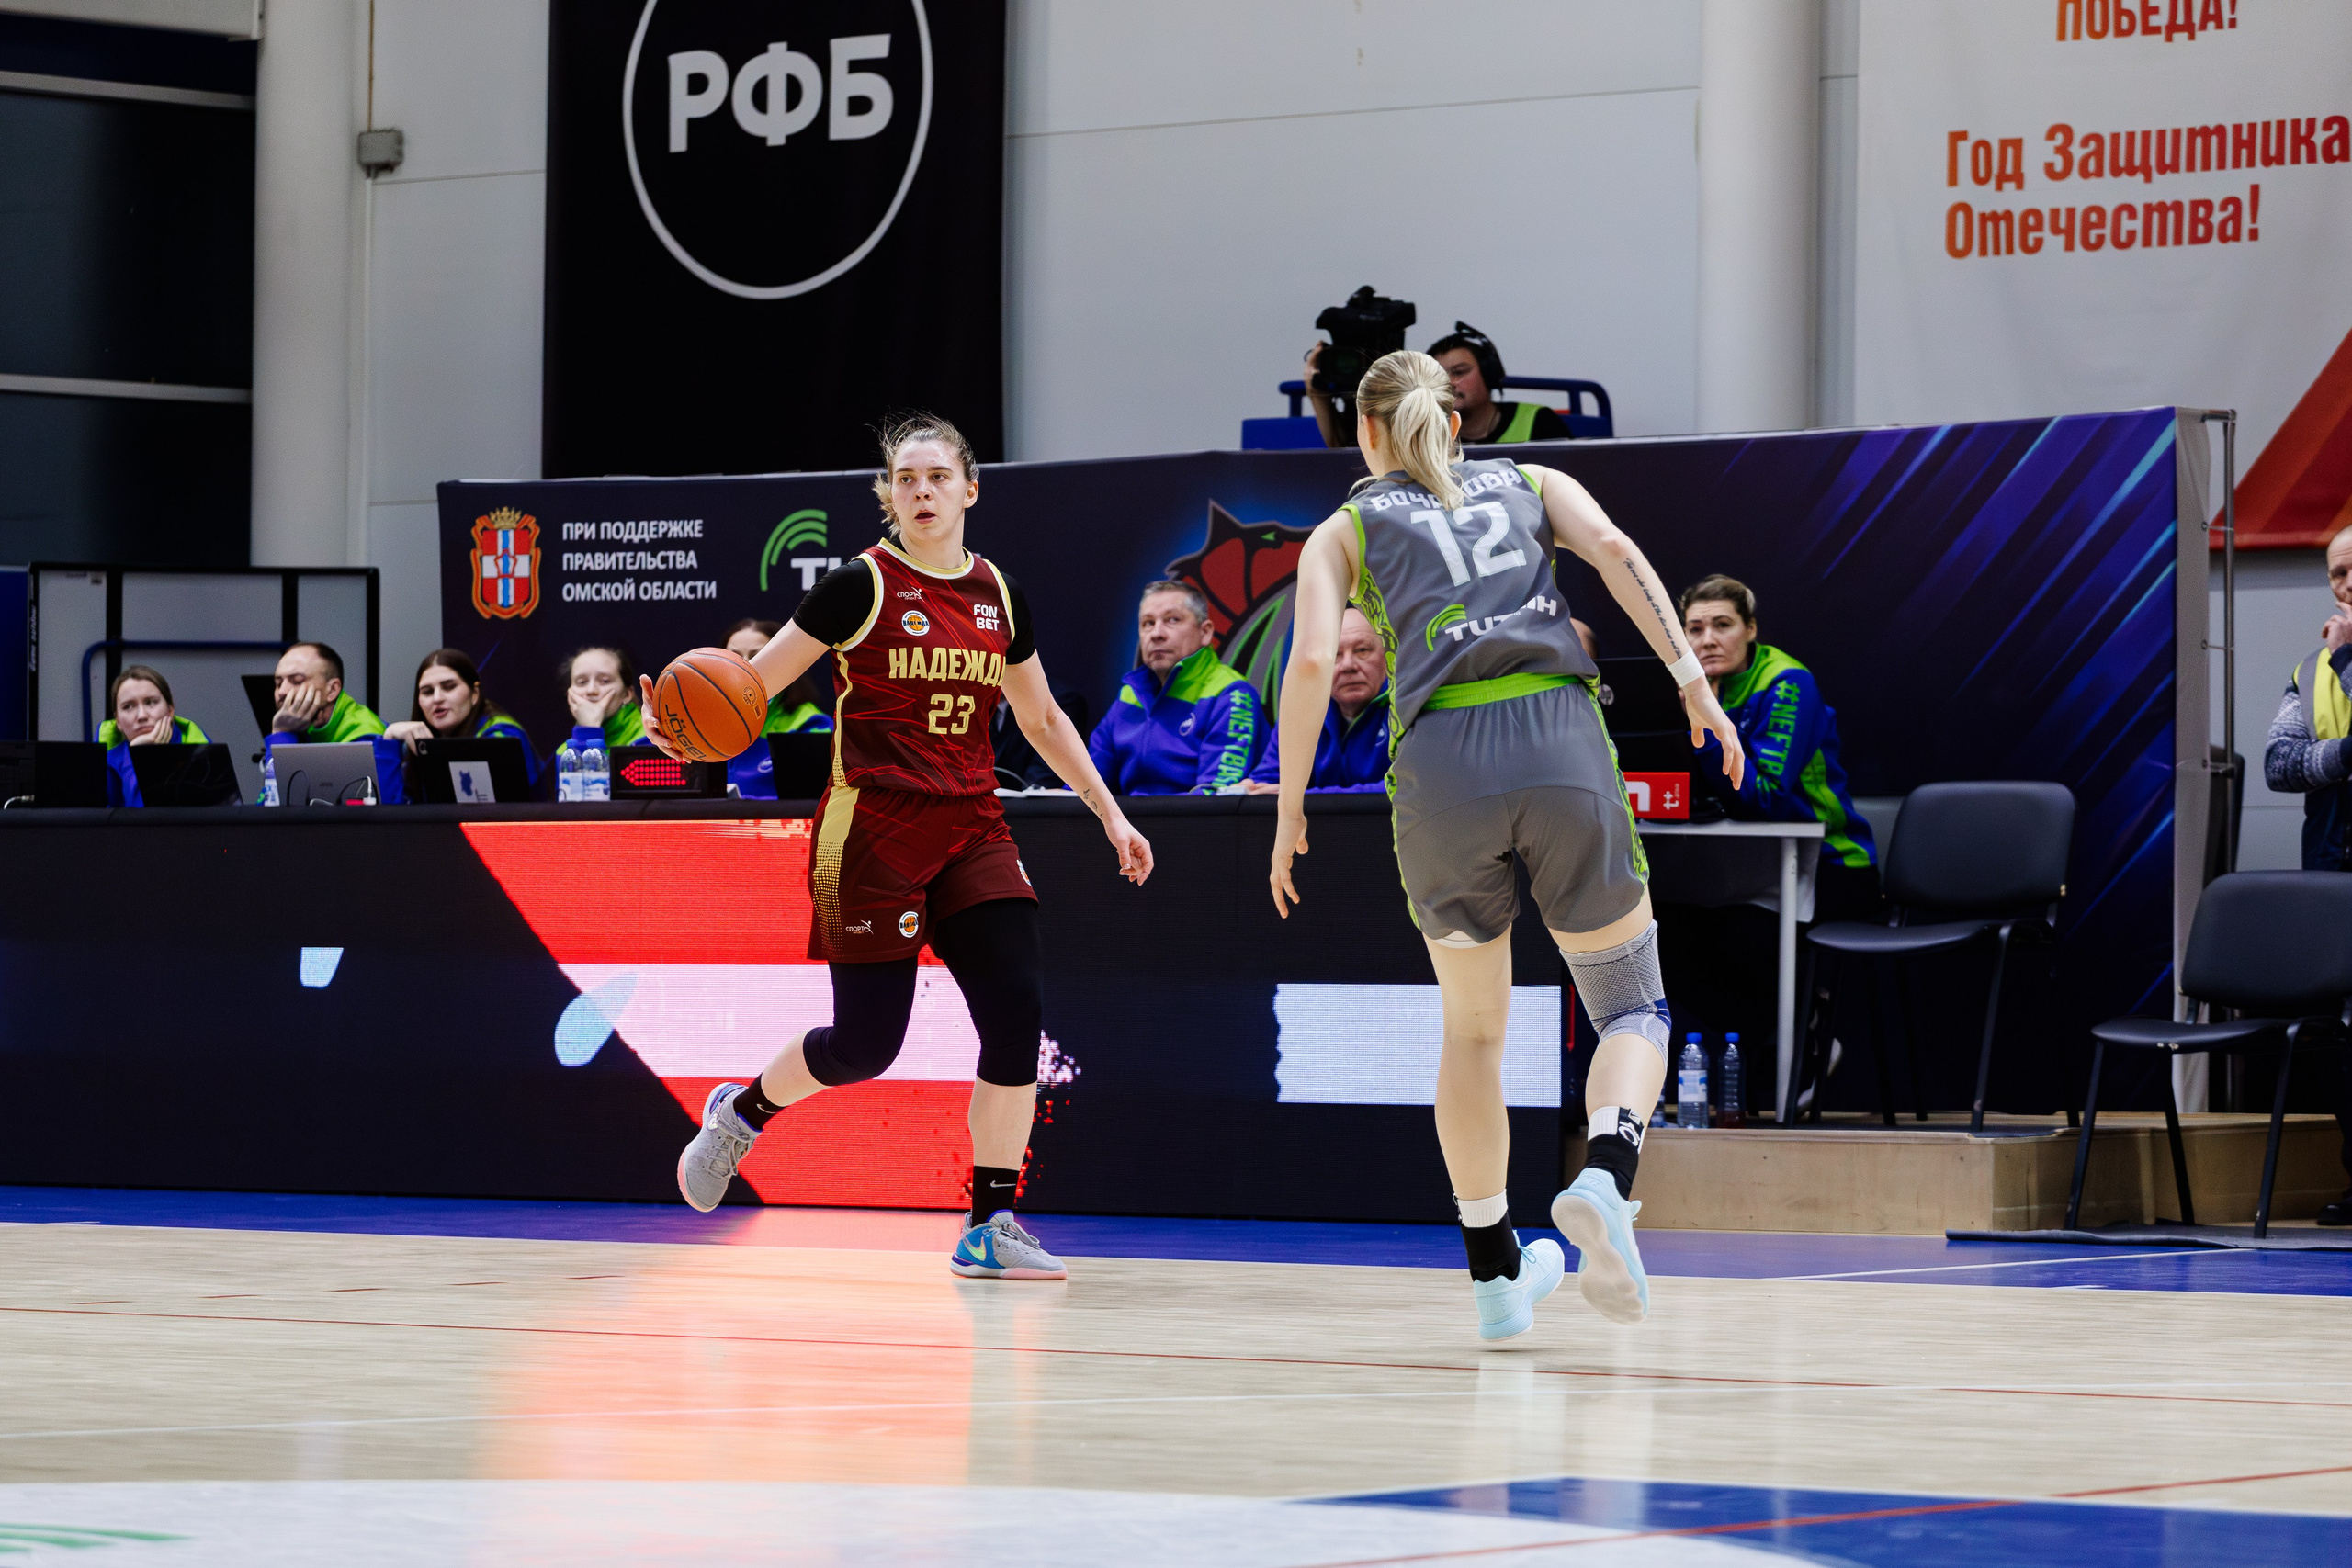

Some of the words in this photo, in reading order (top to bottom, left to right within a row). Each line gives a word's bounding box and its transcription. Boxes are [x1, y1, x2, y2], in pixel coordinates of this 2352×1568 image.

[2056, 0, 2237, 42] ПОБЕДА!
[668, 34, 894, 152] РФБ
[1947, 130, 2024, 191] Год
[2043, 115, 2351, 183] Защитника
[1945, 183, 2260, 259] Отечества!
[562, 522, 596, 541] ПРИ
[600, 519, 703, 543] ПОДДЕРЖКЕ
[1410, 501, 1527, 587] 12
[562, 550, 698, 571] ПРАВИТЕЛЬСТВА
[562, 578, 635, 602] ОМСКОЙ
[639, 581, 717, 601] ОБЛАСТИ
[973, 604, 998, 618] FON
[976, 616, 1000, 631] BET
[928, 694, 976, 734] 23
